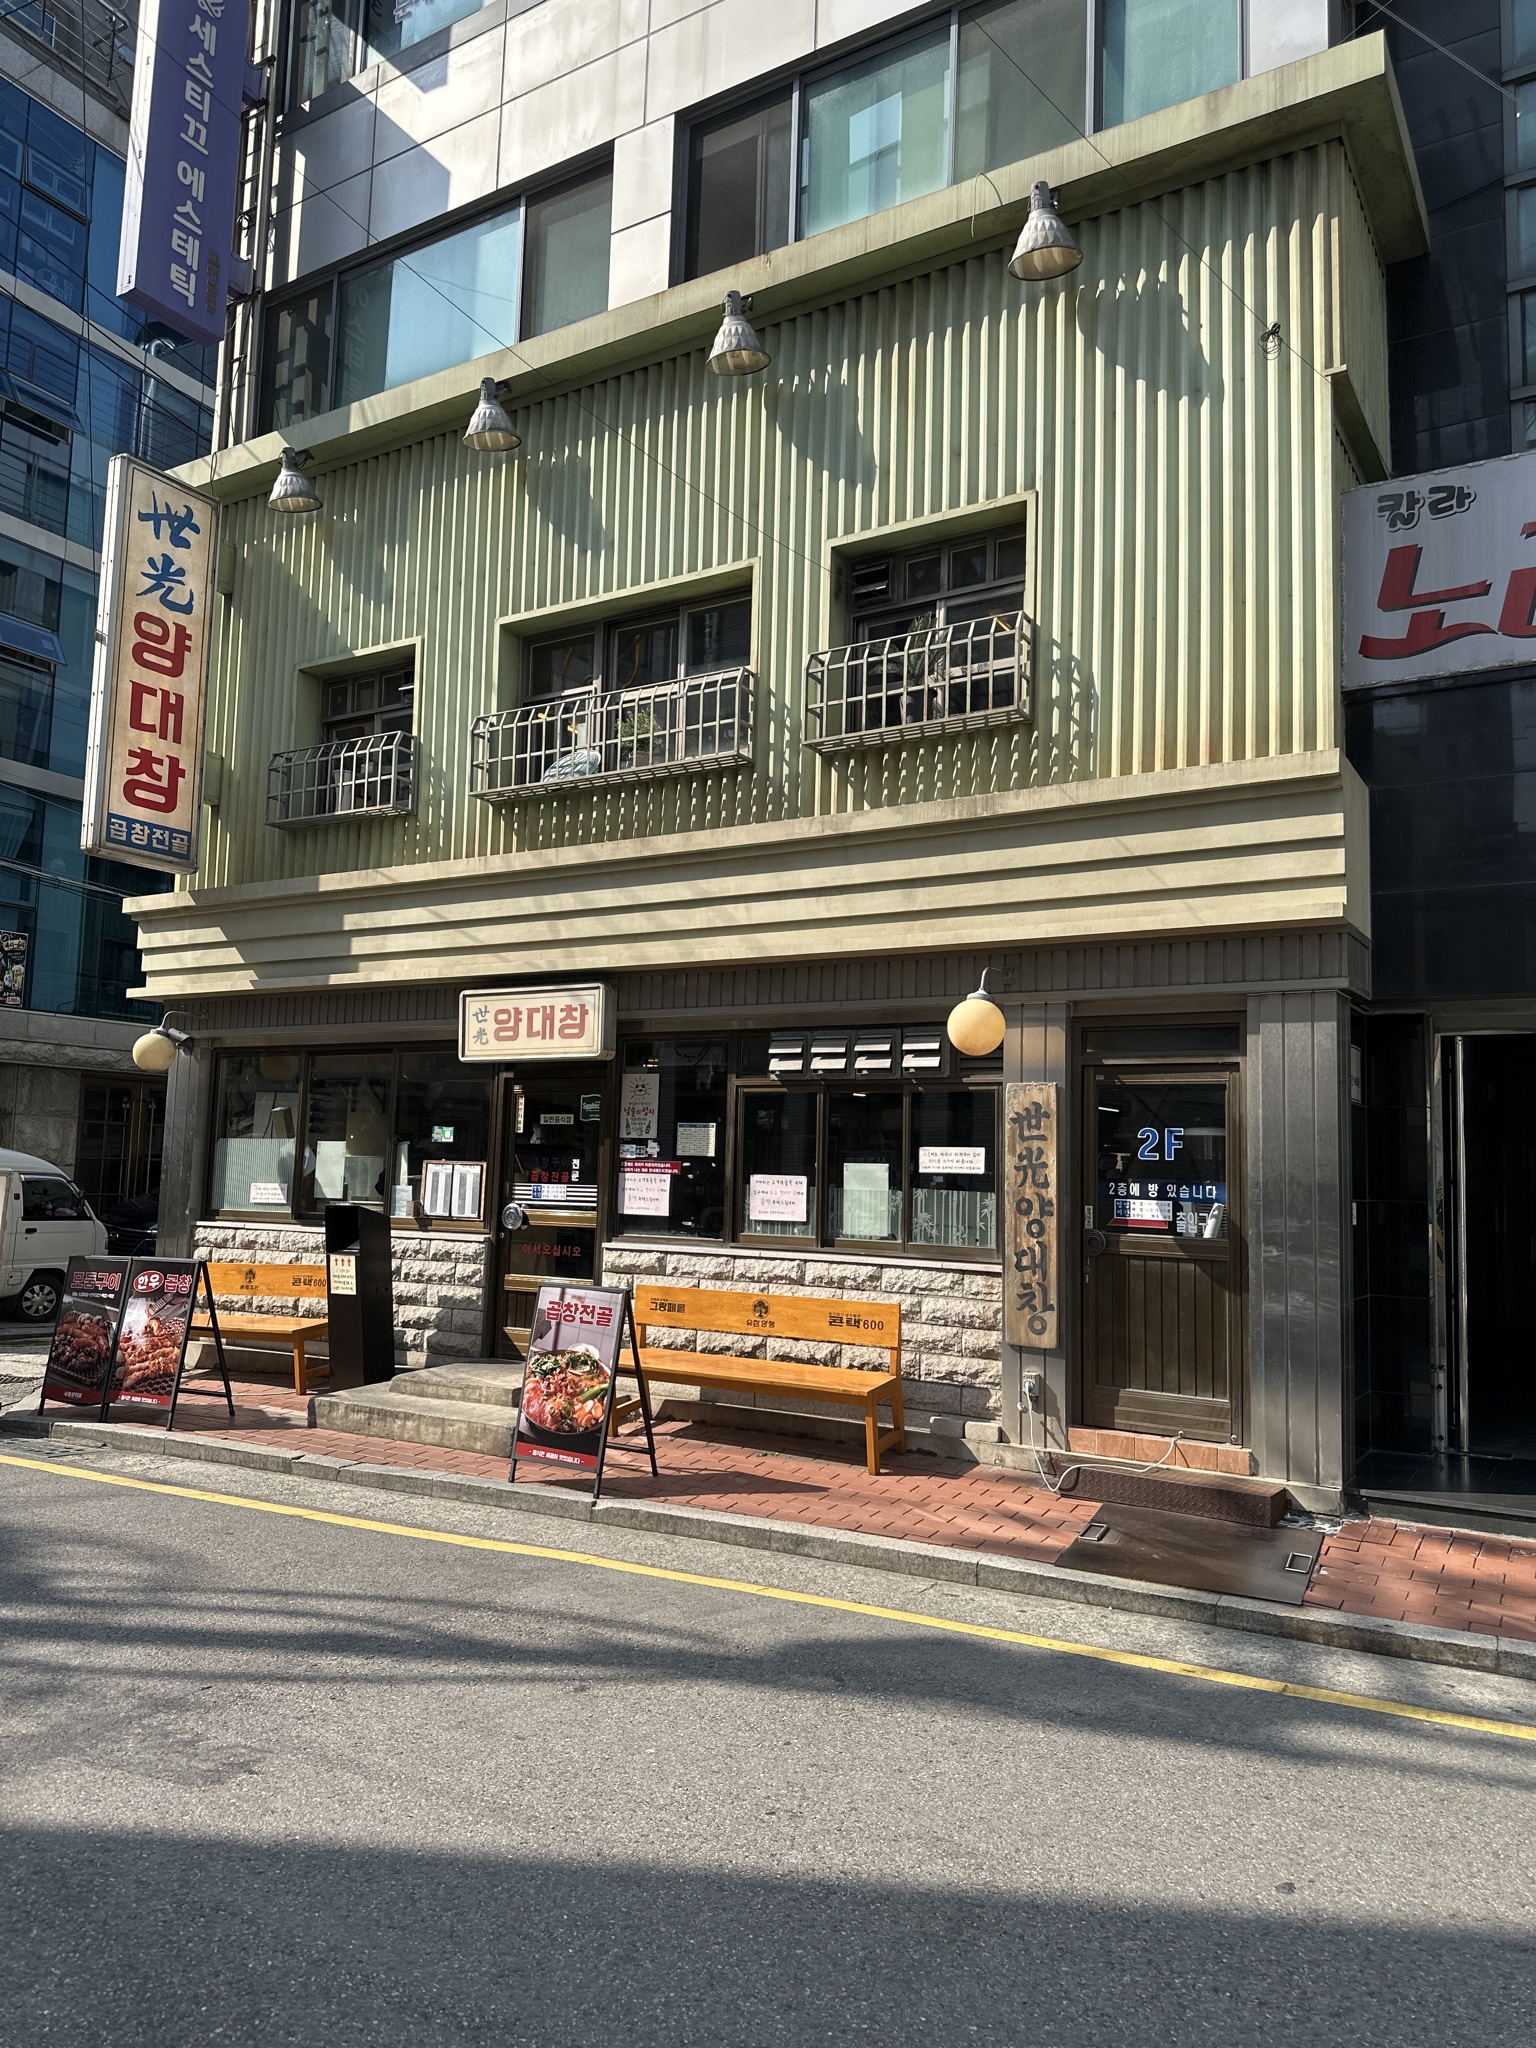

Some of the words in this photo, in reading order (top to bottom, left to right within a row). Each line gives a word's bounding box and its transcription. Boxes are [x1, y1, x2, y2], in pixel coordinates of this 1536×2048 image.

[180, 8, 216, 156] 세스티끄
[170, 160, 205, 308] 에스테틱
[135, 490, 201, 615] 世光
[122, 611, 192, 814] 양대창
[110, 818, 189, 855] 곱창전골
[493, 1004, 589, 1043] 양대창
[543, 1115, 572, 1123] 일반음식점
[1137, 1127, 1184, 1161] 2F
[531, 1171, 569, 1182] 곱창전골
[571, 1159, 580, 1181] 전문
[1109, 1182, 1140, 1196] 2층에
[1148, 1184, 1159, 1197] 방
[1167, 1184, 1217, 1199] 있습니다
[1176, 1211, 1209, 1234] 출입구
[522, 1244, 581, 1257] 어서오십시오
[70, 1272, 121, 1290] 모둠구이
[137, 1275, 161, 1289] 한우
[164, 1274, 192, 1294] 곱창
[545, 1300, 614, 1328] 곱창전골
